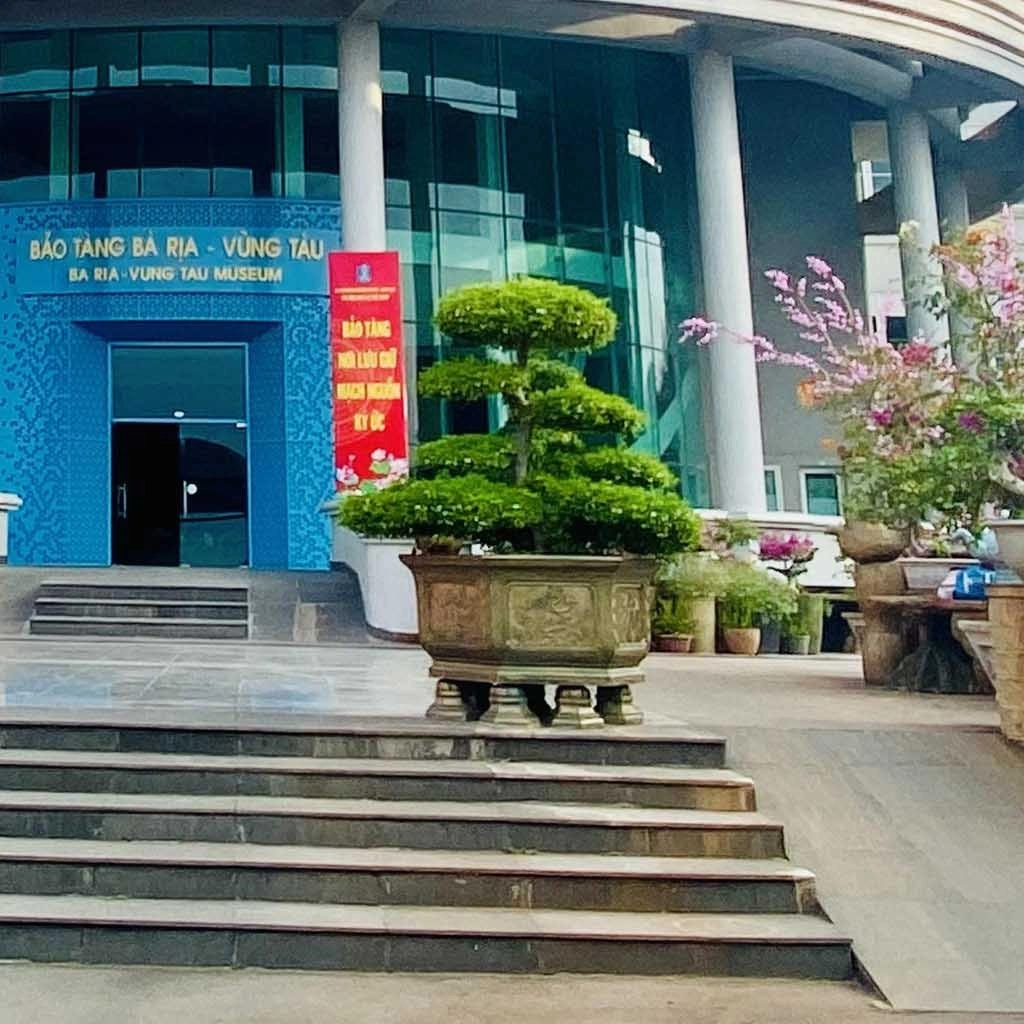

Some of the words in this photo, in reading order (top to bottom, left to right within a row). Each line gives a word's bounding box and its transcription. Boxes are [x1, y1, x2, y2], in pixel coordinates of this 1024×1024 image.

[30, 231, 67, 260] BẢO
[74, 232, 125, 258] TÀNG
[132, 229, 158, 257] BÀ
[166, 236, 199, 262] RỊA
[223, 229, 282, 258] VŨNG
[289, 232, 324, 259] TÀU
[69, 268, 88, 282] BA
[94, 267, 119, 281] RIA
[129, 266, 175, 281] VUNG
[180, 267, 208, 281] TAU
[214, 267, 283, 283] MUSEUM
[342, 314, 363, 339] BẢO
[364, 316, 391, 338] TÀNG
